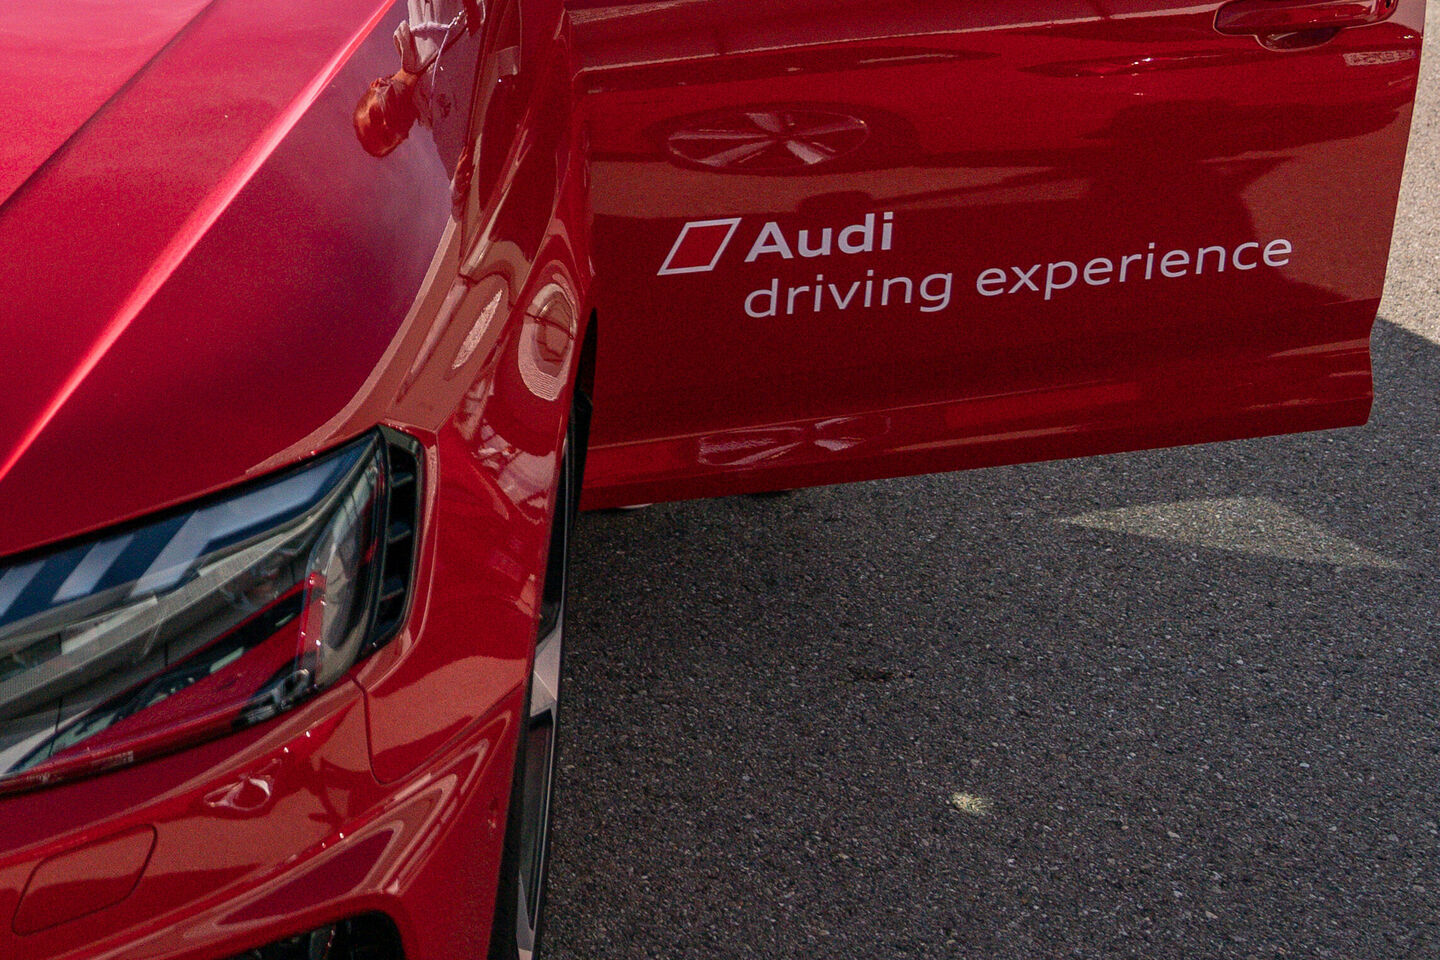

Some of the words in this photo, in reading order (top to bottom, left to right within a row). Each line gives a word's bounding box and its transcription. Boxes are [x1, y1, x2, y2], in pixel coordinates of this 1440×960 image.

[744, 211, 894, 263] Audi
[744, 269, 953, 318] driving
[976, 238, 1293, 300] experience
